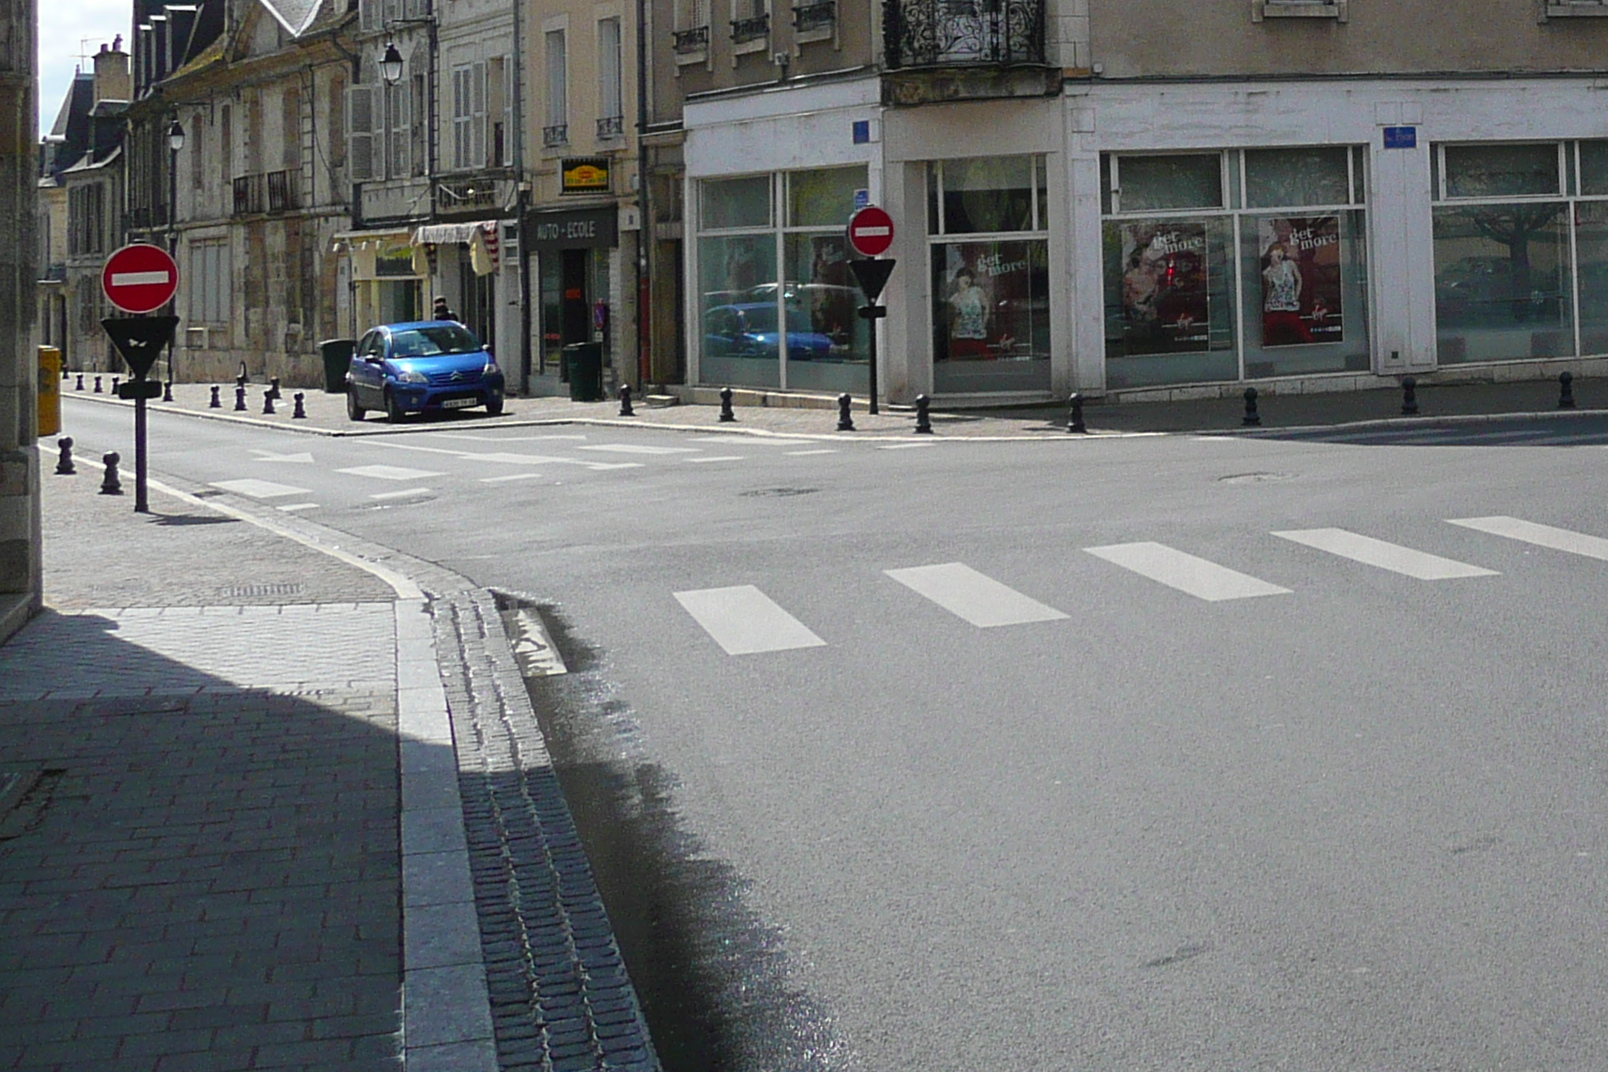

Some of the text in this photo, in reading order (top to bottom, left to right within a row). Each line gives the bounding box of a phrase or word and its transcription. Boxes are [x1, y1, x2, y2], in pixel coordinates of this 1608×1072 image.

[1153, 230, 1181, 250] get
[1164, 236, 1204, 254] more
[1289, 227, 1314, 247] get
[1300, 233, 1338, 251] more
